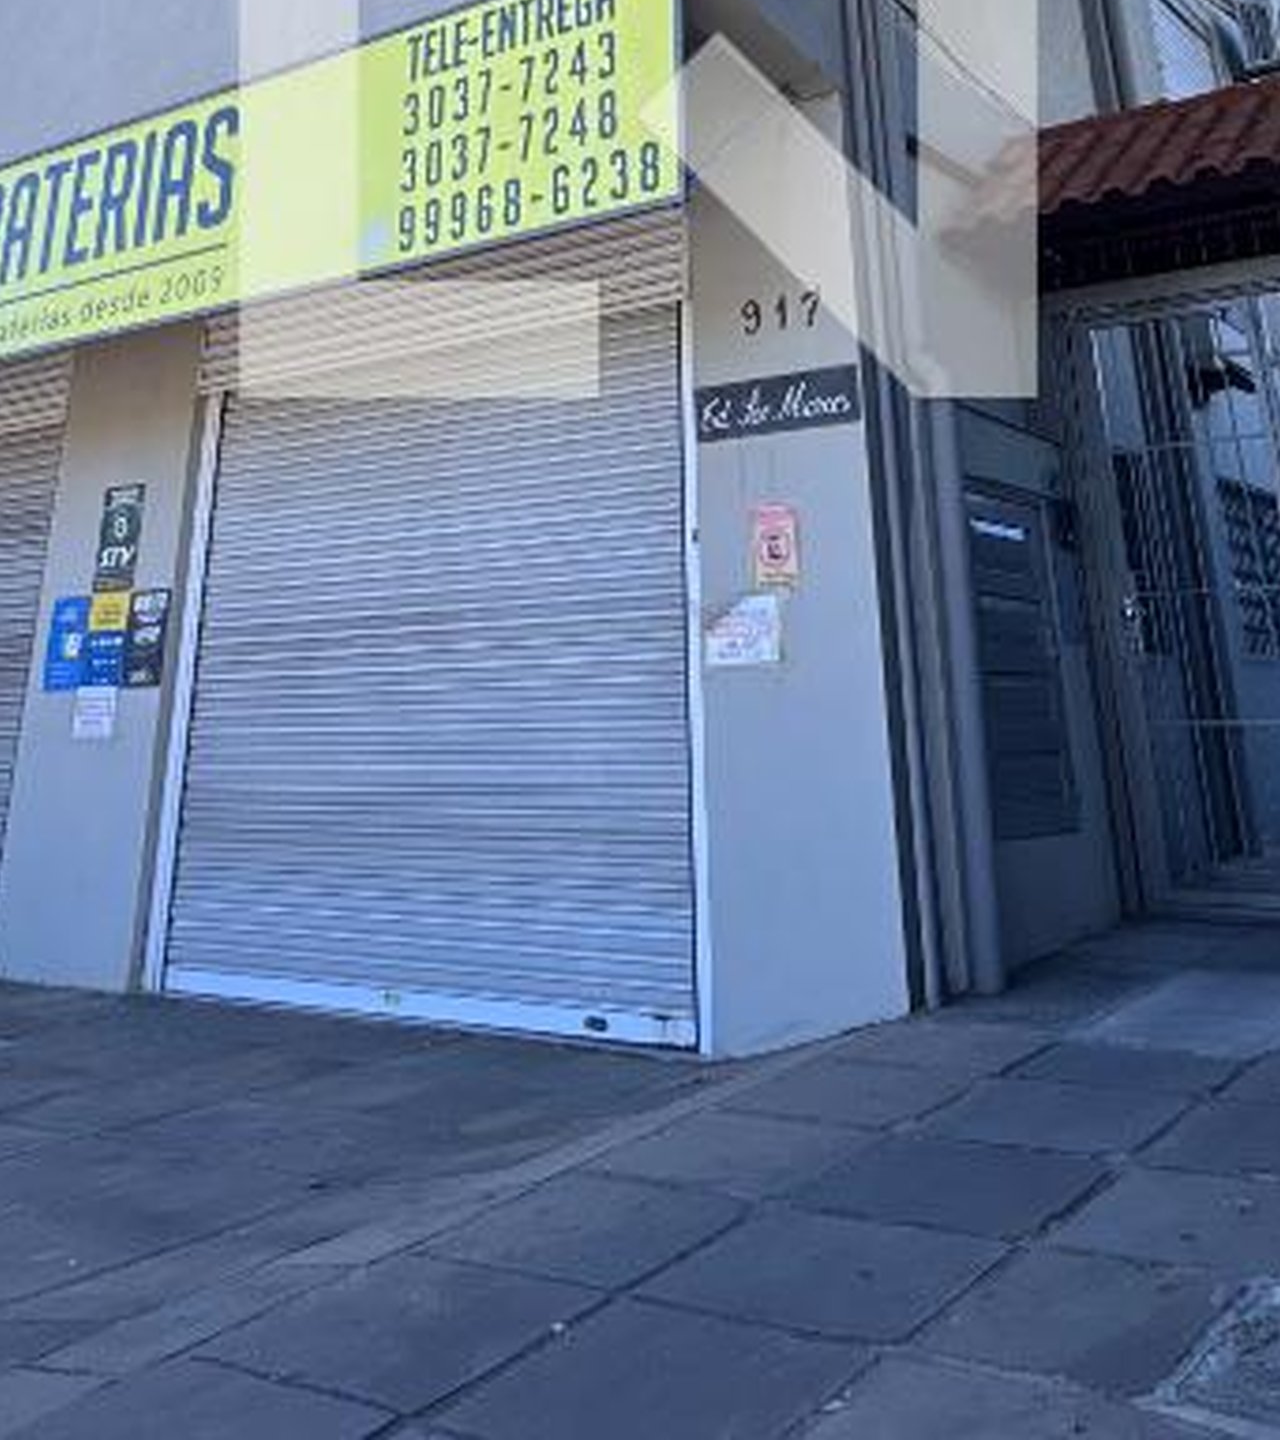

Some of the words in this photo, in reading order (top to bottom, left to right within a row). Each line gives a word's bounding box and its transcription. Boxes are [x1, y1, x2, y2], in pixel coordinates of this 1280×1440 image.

[403, 32, 615, 135] 3037-7243
[400, 90, 617, 192] 3037-7248
[399, 141, 660, 252] 99968-6238
[740, 290, 820, 335] 917
